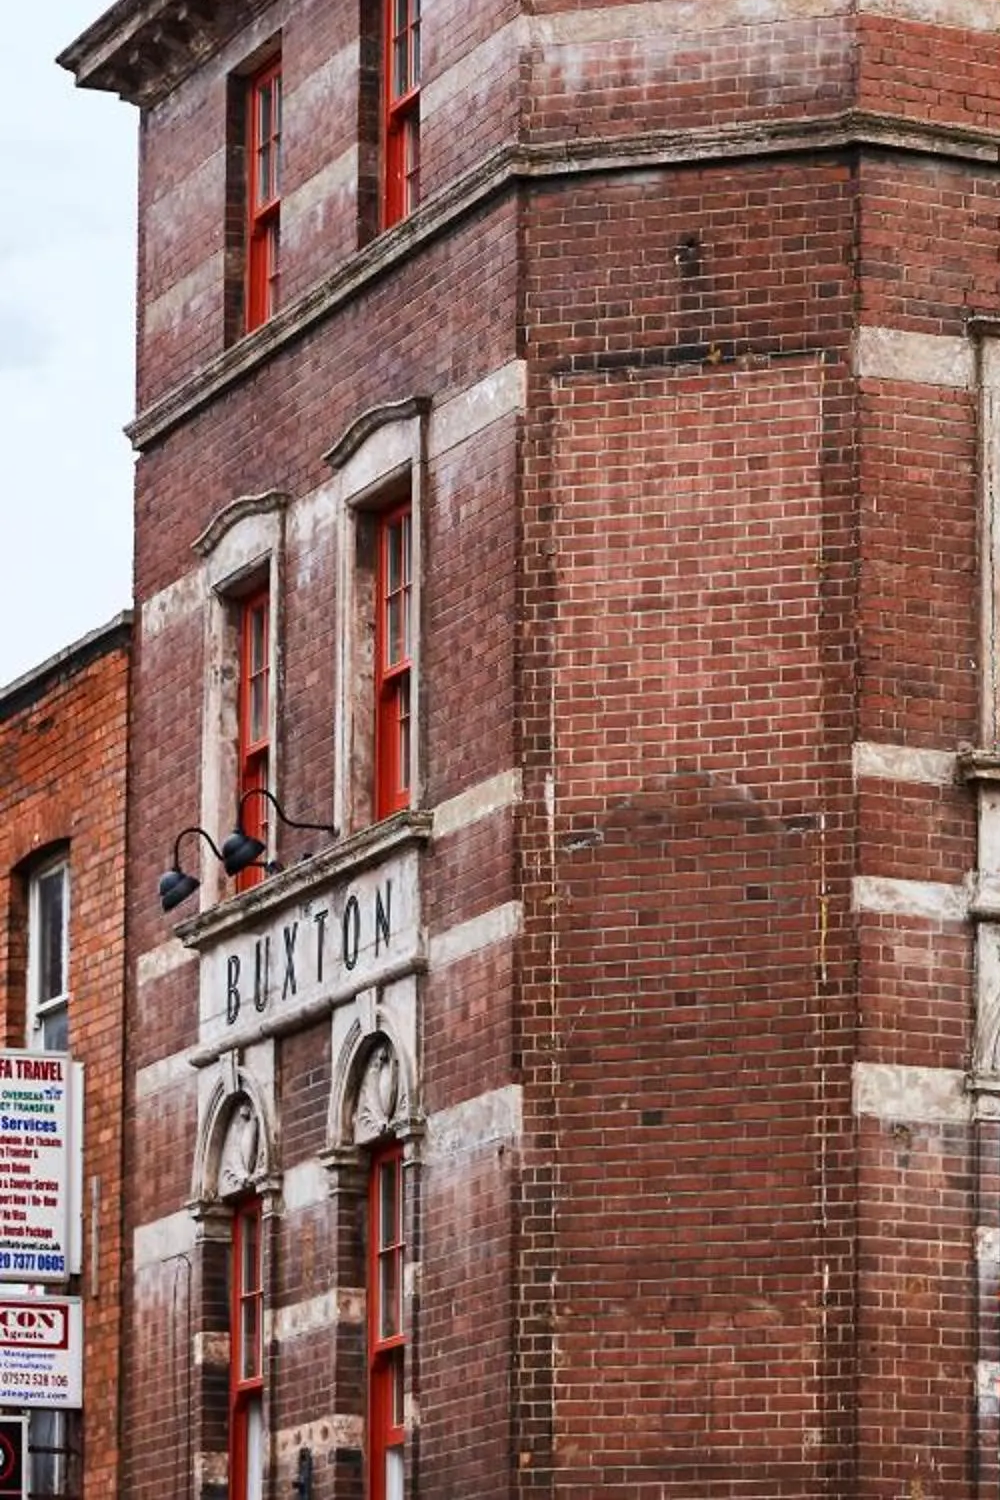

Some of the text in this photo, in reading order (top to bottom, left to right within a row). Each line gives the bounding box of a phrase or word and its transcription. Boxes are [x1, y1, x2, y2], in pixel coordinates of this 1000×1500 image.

[227, 879, 392, 1025] BUXTON
[16, 1060, 63, 1081] TRAVEL
[14, 1102, 54, 1113] TRANSFER
[2, 1116, 56, 1132] Services
[34, 1180, 58, 1191] Service
[26, 1226, 52, 1238] Package
[13, 1253, 35, 1269] 7377
[38, 1254, 64, 1271] 0605
[1, 1328, 44, 1340] Agents
[4, 1350, 55, 1360] Management
